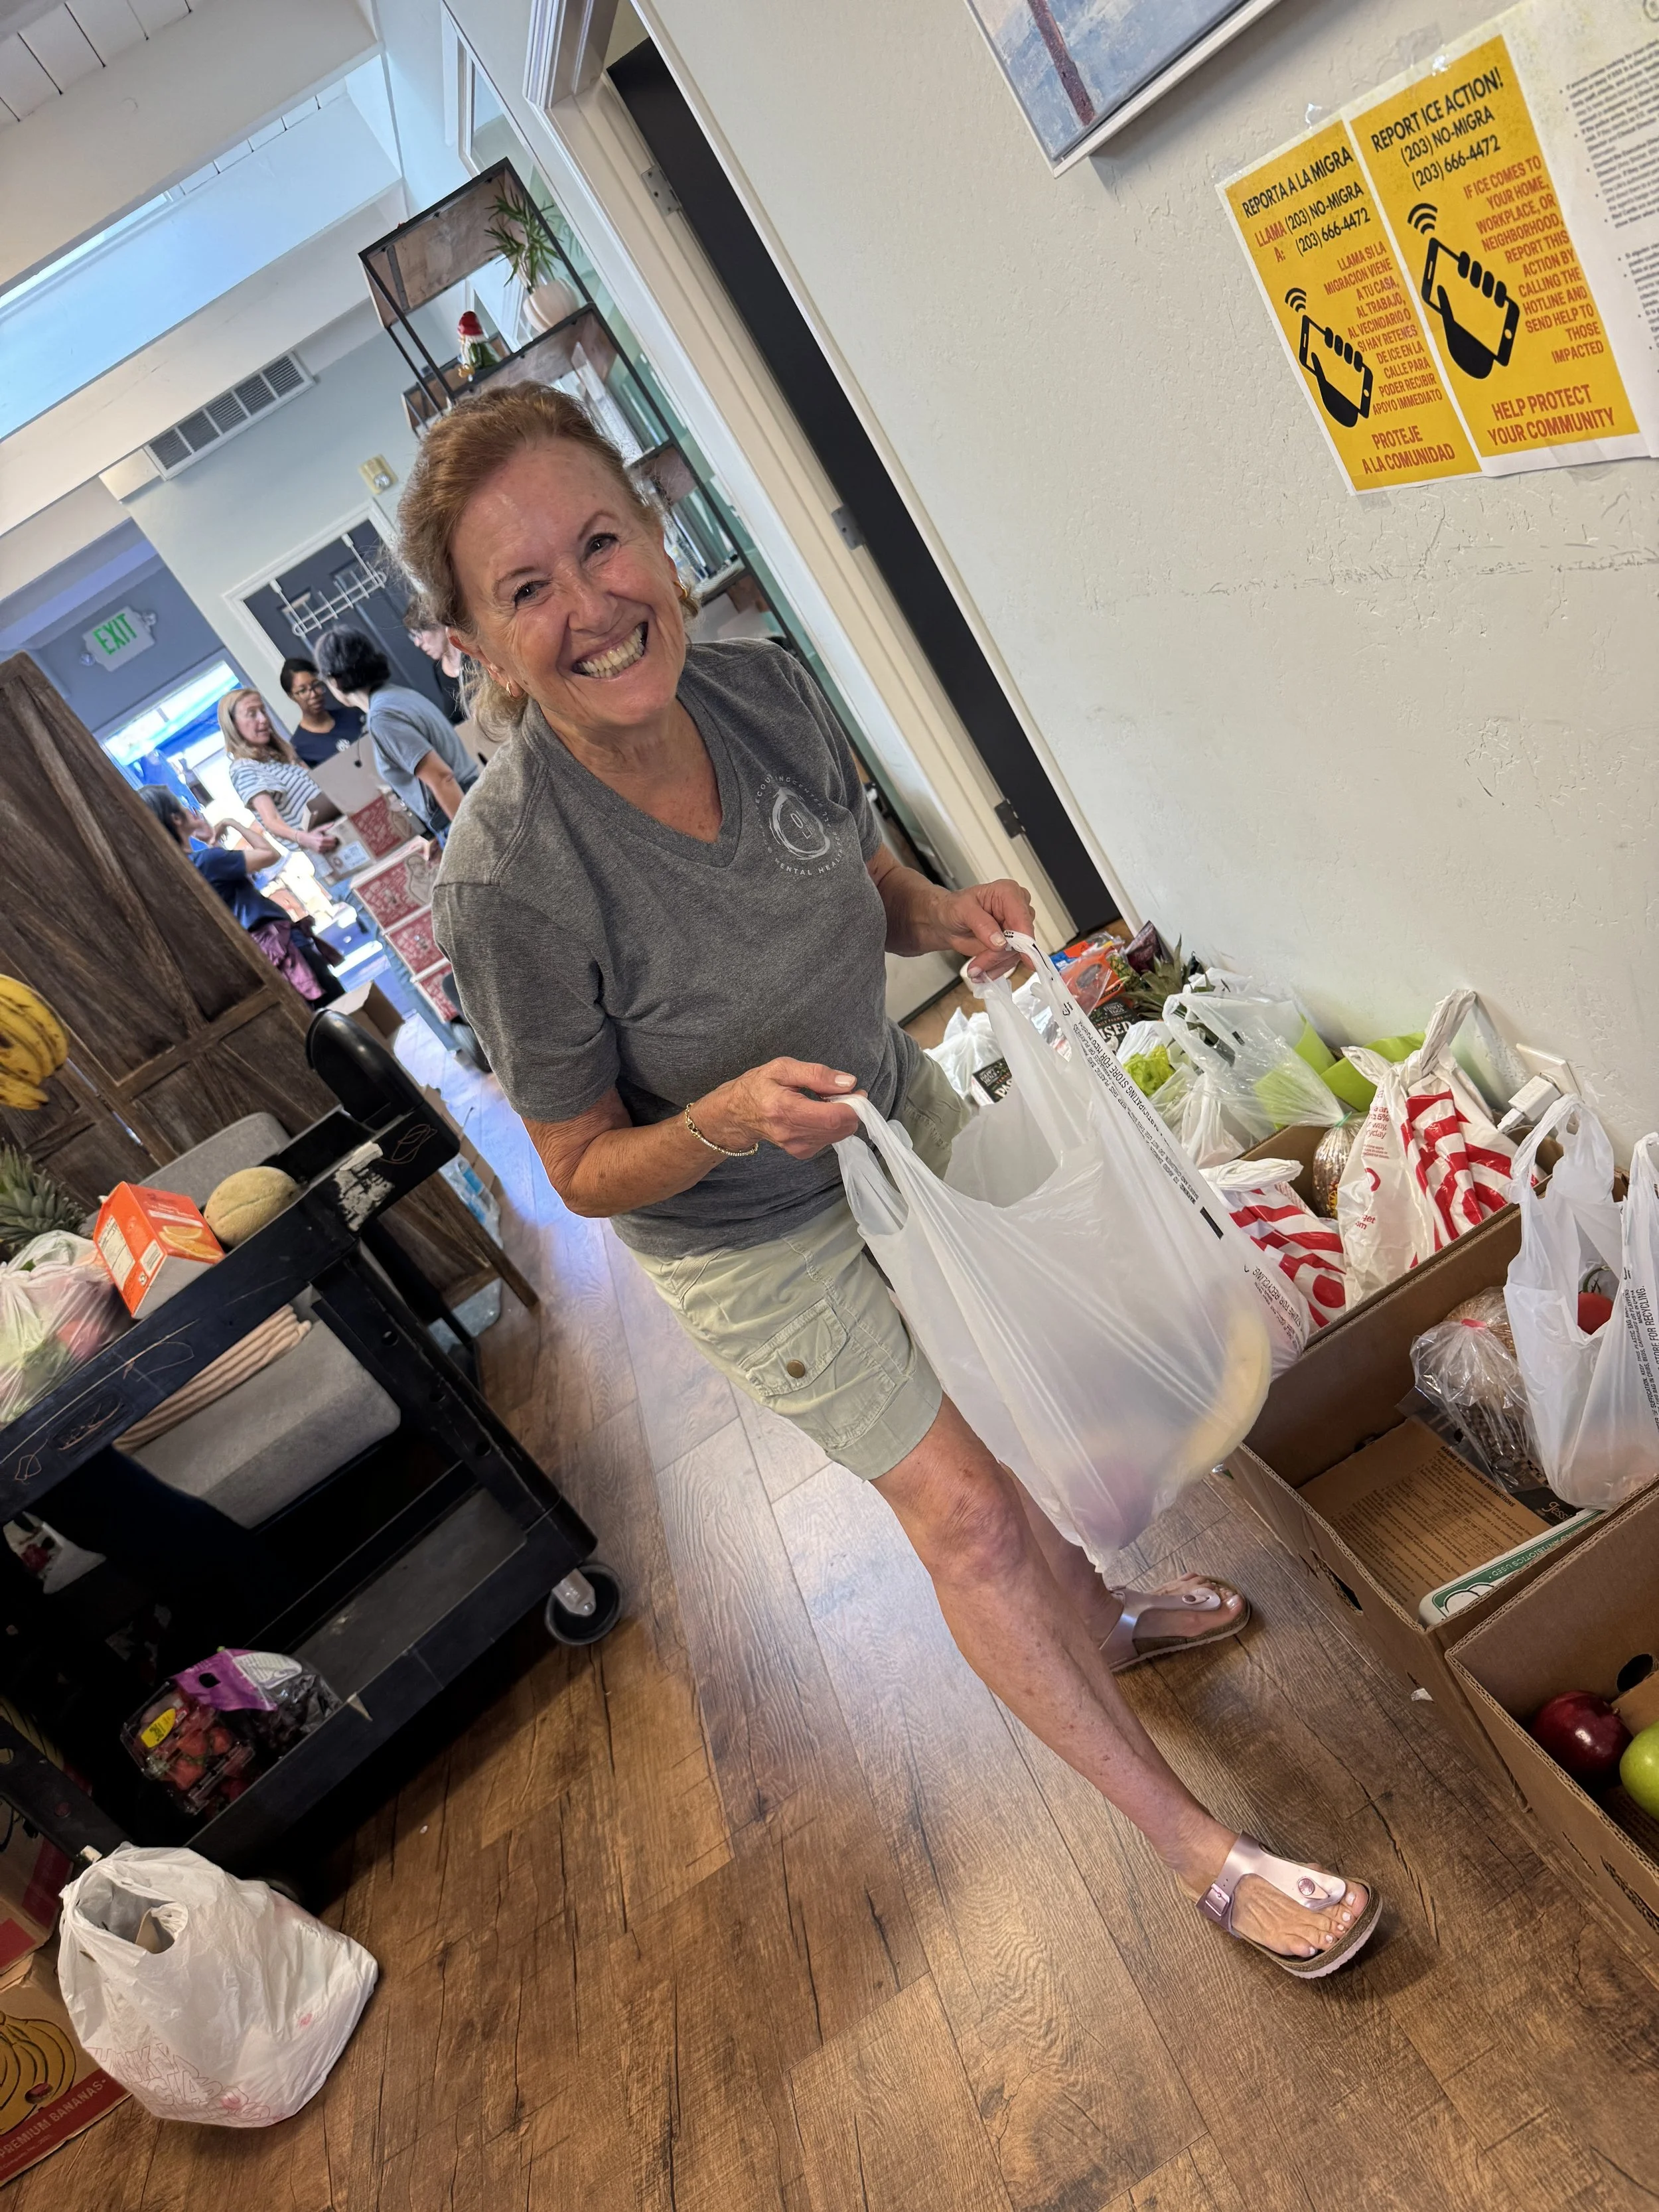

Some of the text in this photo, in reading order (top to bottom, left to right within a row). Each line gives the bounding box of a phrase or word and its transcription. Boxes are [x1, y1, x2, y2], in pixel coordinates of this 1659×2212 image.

[1371, 66, 1503, 153] REPORT ICE ACTION!
[1401, 106, 1495, 167] (203) NO-MIGRA
[1412, 135, 1501, 191] (203) 666-4472
[1463, 155, 1542, 200] IF ICE COMES TO
[1242, 146, 1354, 218] REPORTA A LA MIGRA
[1486, 175, 1550, 210] YOUR HOME,
[1254, 182, 1364, 248] LLAMA (203) NO-MIGRA
[1476, 193, 1556, 235] WORKPLACE, OR
[1295, 207, 1371, 257] (203) 666-4472
[1481, 213, 1564, 253] NEIGHBORHOOD,
[1504, 230, 1570, 264] REPORT THIS
[1274, 247, 1286, 263] A:
[1336, 241, 1387, 271] LLAMA SI LA
[1522, 248, 1575, 277] ACTION BY
[1323, 258, 1393, 295] MIGRACION VIENE
[1356, 275, 1400, 301] A TU CASA,
[1518, 266, 1582, 298] CALLING THE
[1356, 291, 1406, 319] AL TRABAJO,
[1522, 285, 1587, 316] HOTLINE AND
[1347, 307, 1411, 340] AL VECINDARIO O
[1525, 303, 1594, 334] SEND HELP TO
[1565, 321, 1601, 342] THOSE
[1357, 325, 1418, 353] SI HAY RETENES
[1376, 340, 1425, 364] DE ICE EN LA
[1551, 340, 1604, 364] IMPACTED
[1384, 356, 1431, 380] CALLE PARA
[1378, 372, 1437, 397] PODER RECIBIR
[1372, 388, 1443, 415] APOYO IMMEDIATO
[1491, 384, 1591, 421] HELP PROTECT
[1371, 425, 1423, 450] PROTEJE
[1486, 407, 1615, 446] YOUR COMMUNITY
[1362, 443, 1456, 475] A LA COMUNIDAD
[92, 613, 137, 655] EXIT
[774, 857, 812, 875] MENTAL
[818, 848, 844, 874] HEALTH
[1098, 1021, 1132, 1040] ISED
[1101, 1053, 1113, 1069] FOR
[1110, 1065, 1128, 1088] STORE
[1372, 1122, 1387, 1131] way,
[1377, 1114, 1389, 1122] 5%
[1252, 1266, 1279, 1300] RECYCLING.
[1279, 1297, 1289, 1311] FOR
[1625, 1290, 1634, 1313] PLAYPENS
[1636, 1286, 1655, 1325] RECYCLING.
[1630, 1330, 1638, 1349] PLASTIC
[1647, 1327, 1659, 1341] FOR
[1440, 1446, 1516, 1507] BAKING AND HANDLING INSTRUCTIONS
[1492, 1564, 1513, 1576] USED
[0, 2118, 51, 2157] PREMIUM
[49, 2081, 104, 2122] BANANAS
